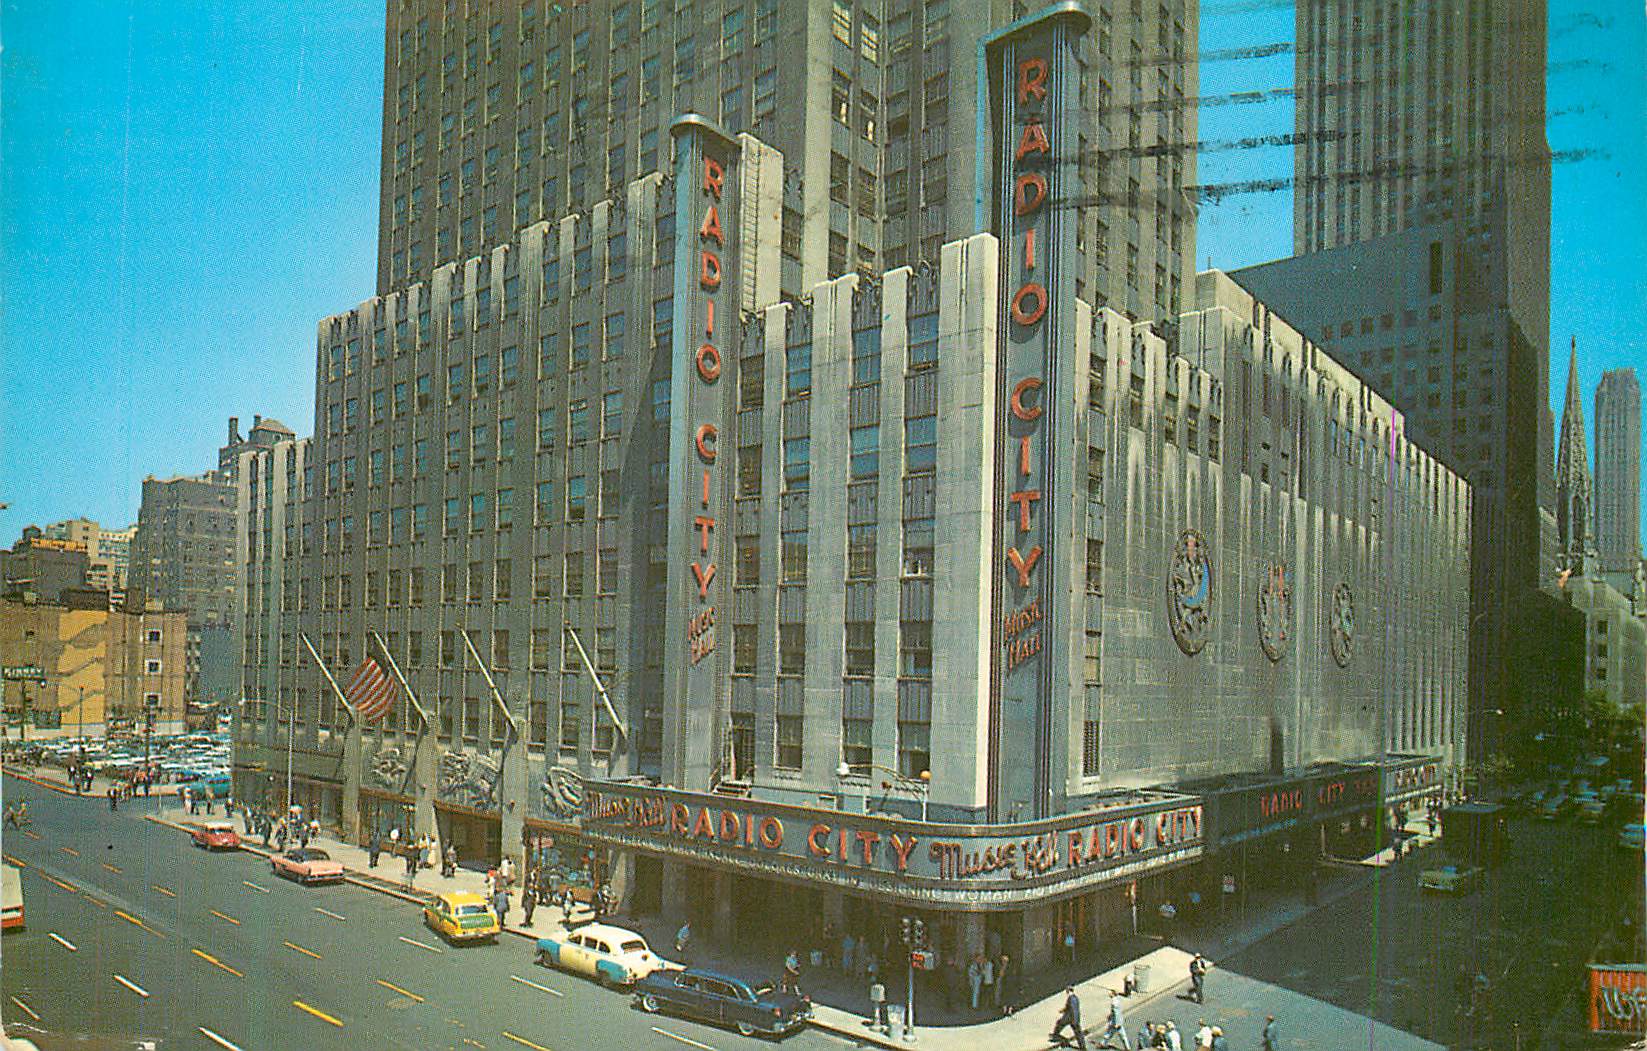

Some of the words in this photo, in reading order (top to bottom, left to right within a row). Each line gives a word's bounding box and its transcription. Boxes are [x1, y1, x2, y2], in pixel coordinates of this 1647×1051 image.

[696, 156, 723, 384] RADIO
[1011, 58, 1049, 325] RADIO
[691, 423, 719, 600] CITY
[1007, 376, 1043, 588] CITY
[671, 802, 784, 849] RADIO
[807, 822, 919, 870] CITY
[1068, 817, 1145, 868] RADIO
[1157, 805, 1203, 845] CITY
[1261, 788, 1303, 817] RADIO
